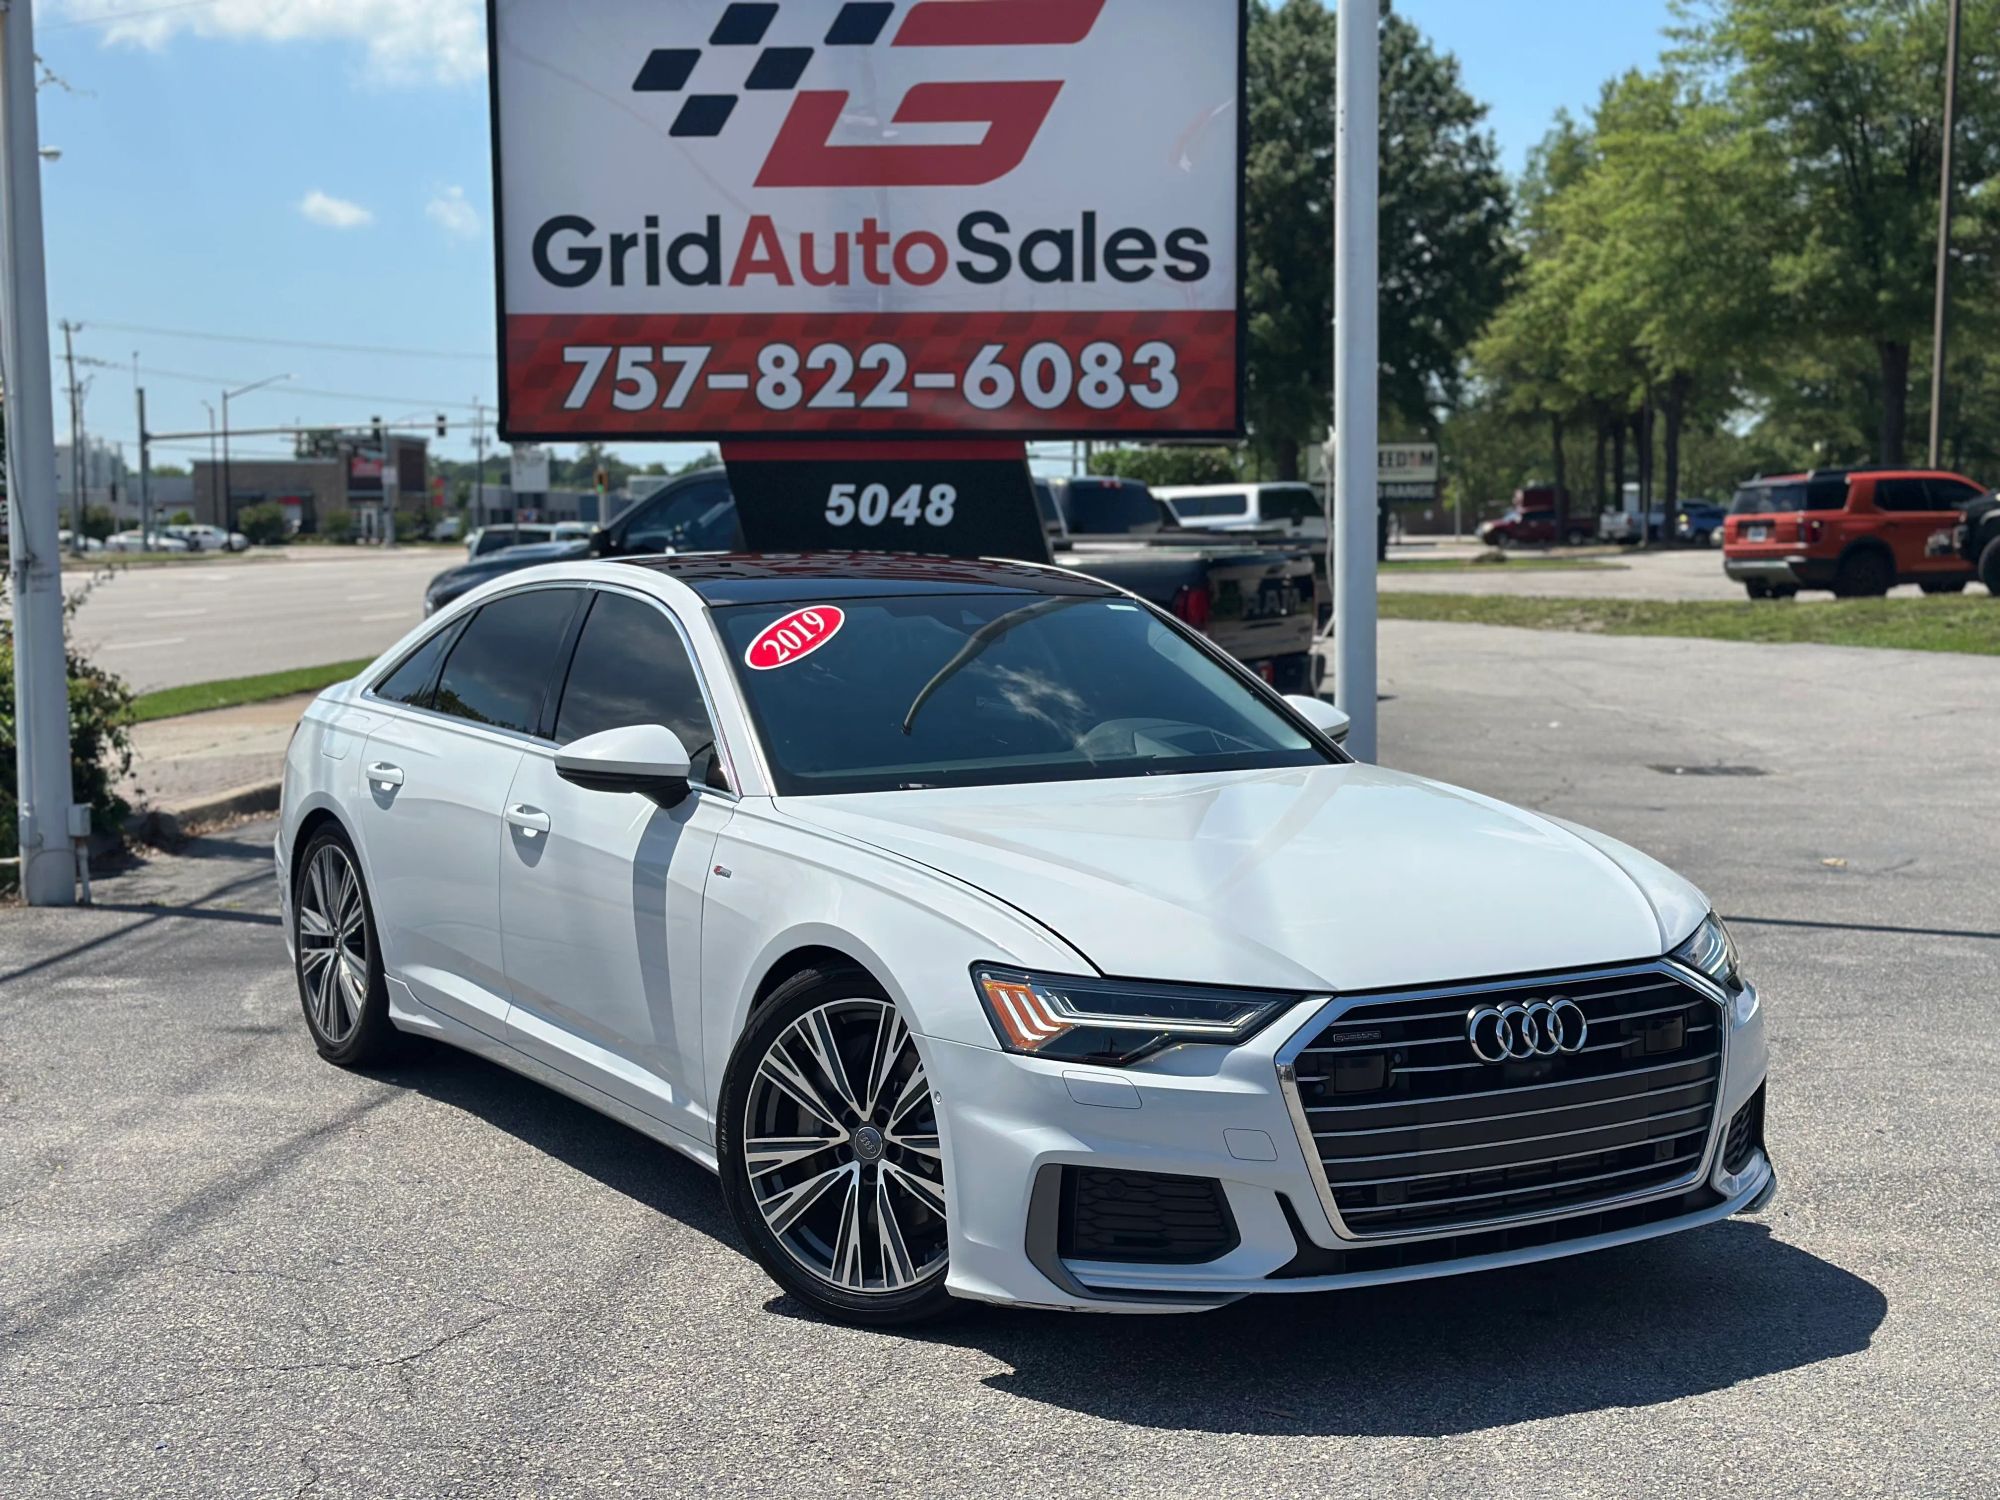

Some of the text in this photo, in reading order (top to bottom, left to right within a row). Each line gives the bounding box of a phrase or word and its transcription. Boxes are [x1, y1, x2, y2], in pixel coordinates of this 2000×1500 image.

[532, 209, 1211, 288] GridAutoSales
[562, 341, 1180, 411] 757-822-6083
[824, 482, 957, 527] 5048
[762, 611, 825, 662] 2019
